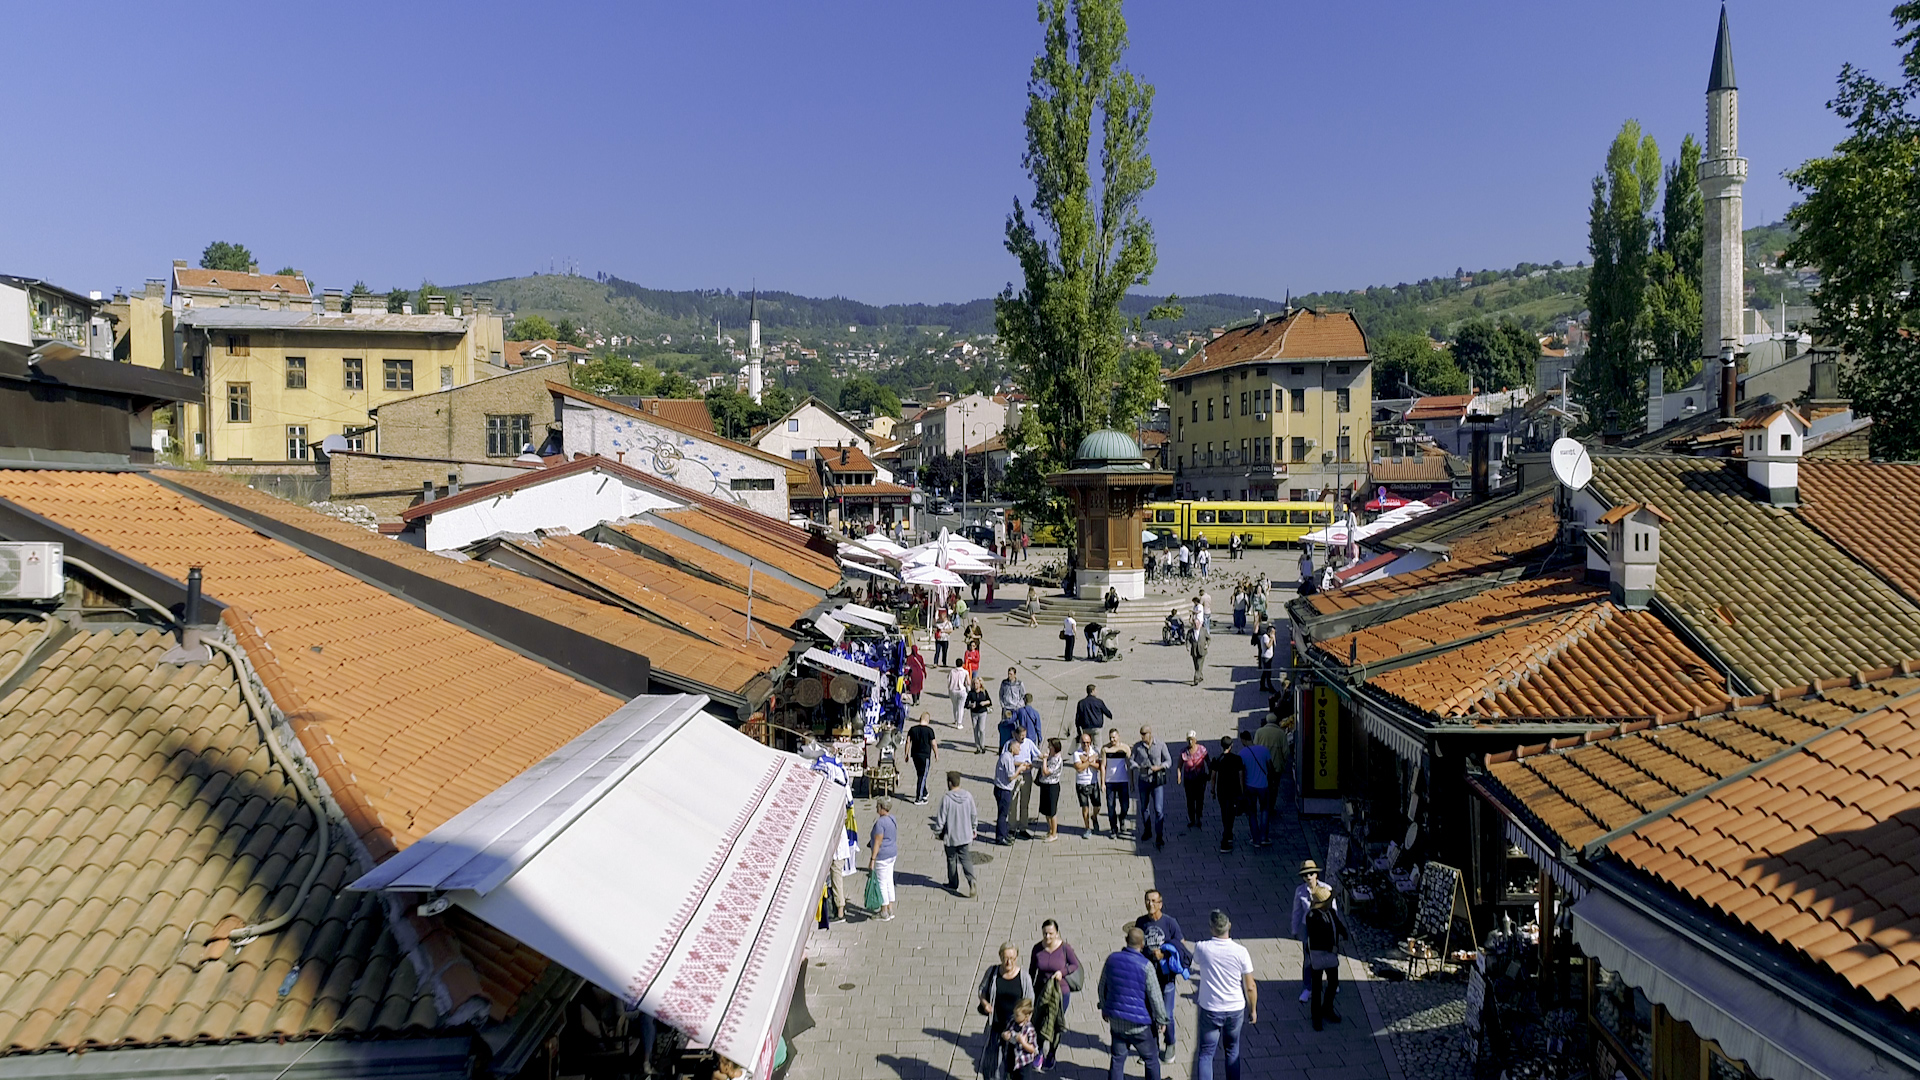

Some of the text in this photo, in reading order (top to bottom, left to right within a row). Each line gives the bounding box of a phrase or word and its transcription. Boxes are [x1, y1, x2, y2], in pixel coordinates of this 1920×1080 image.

[1396, 436, 1414, 444] HOTEL
[1318, 687, 1328, 777] I SARAJEVO
